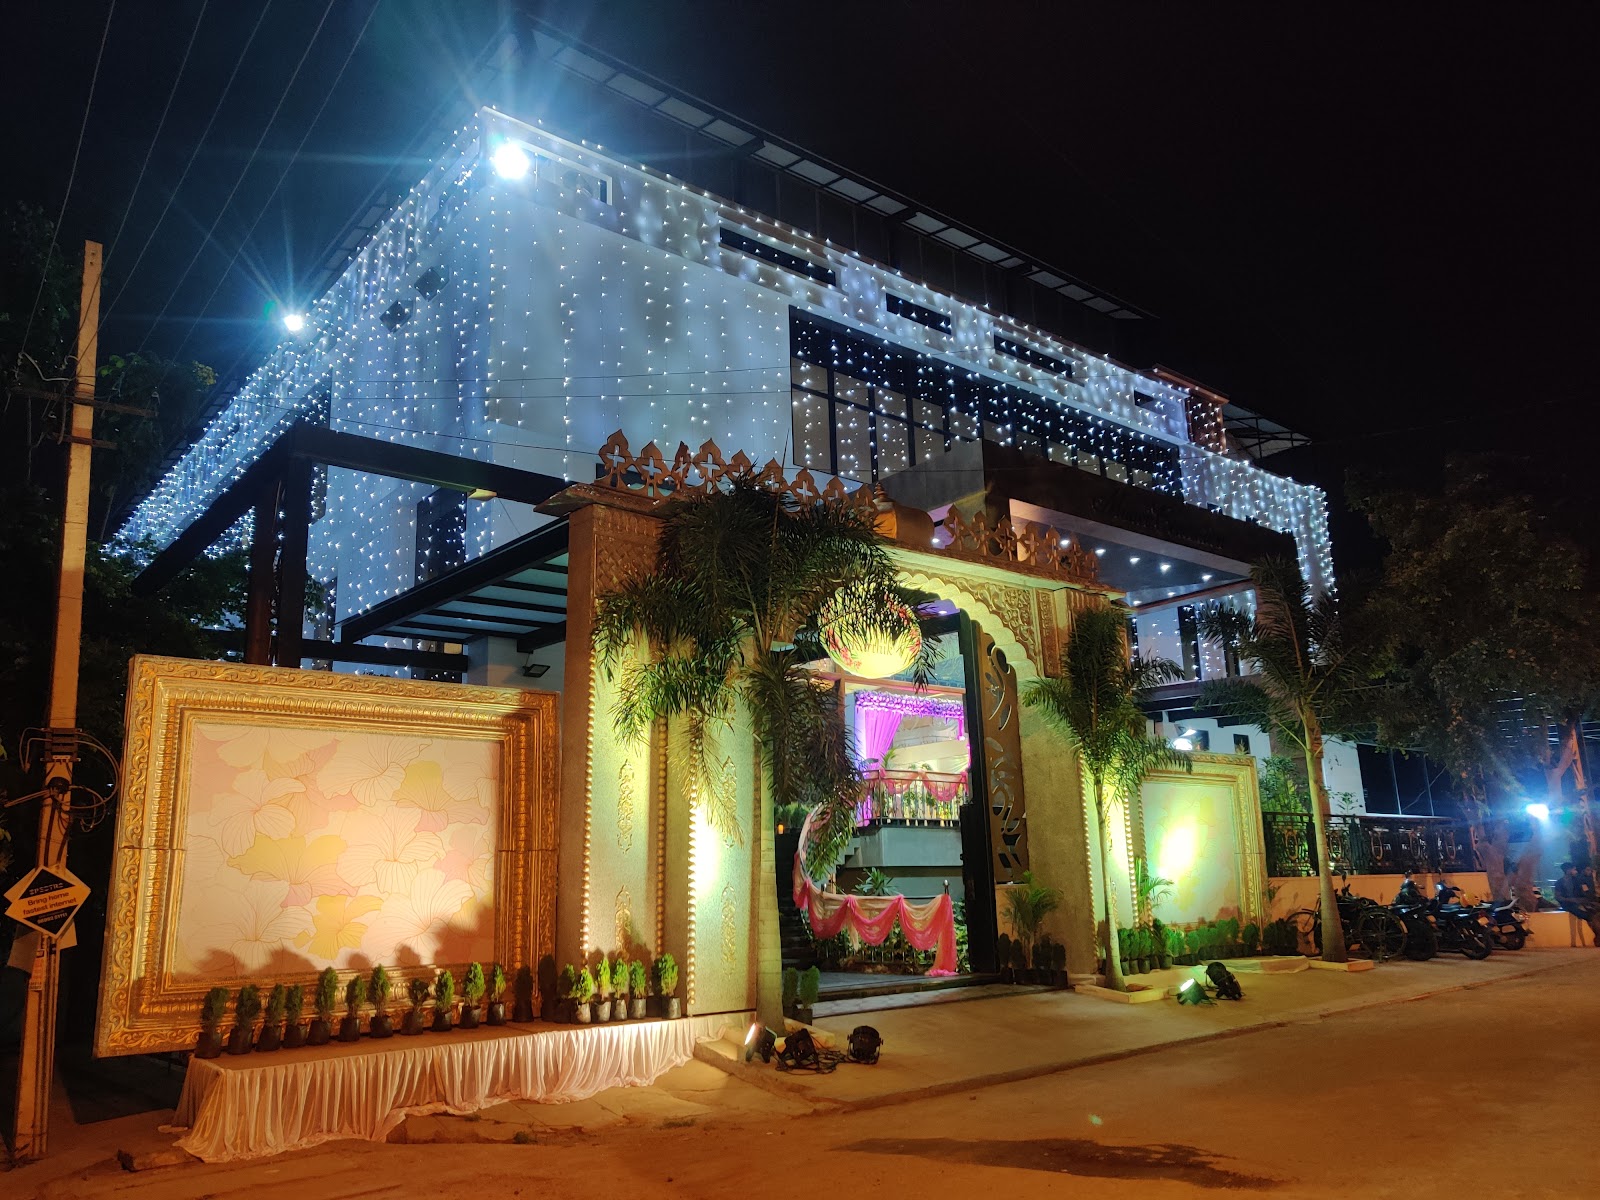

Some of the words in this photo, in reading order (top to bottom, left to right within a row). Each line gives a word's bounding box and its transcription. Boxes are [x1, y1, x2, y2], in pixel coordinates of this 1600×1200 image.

[23, 905, 48, 915] fastest
[49, 897, 77, 908] internet
[28, 897, 47, 906] Bring
[49, 892, 69, 900] home
